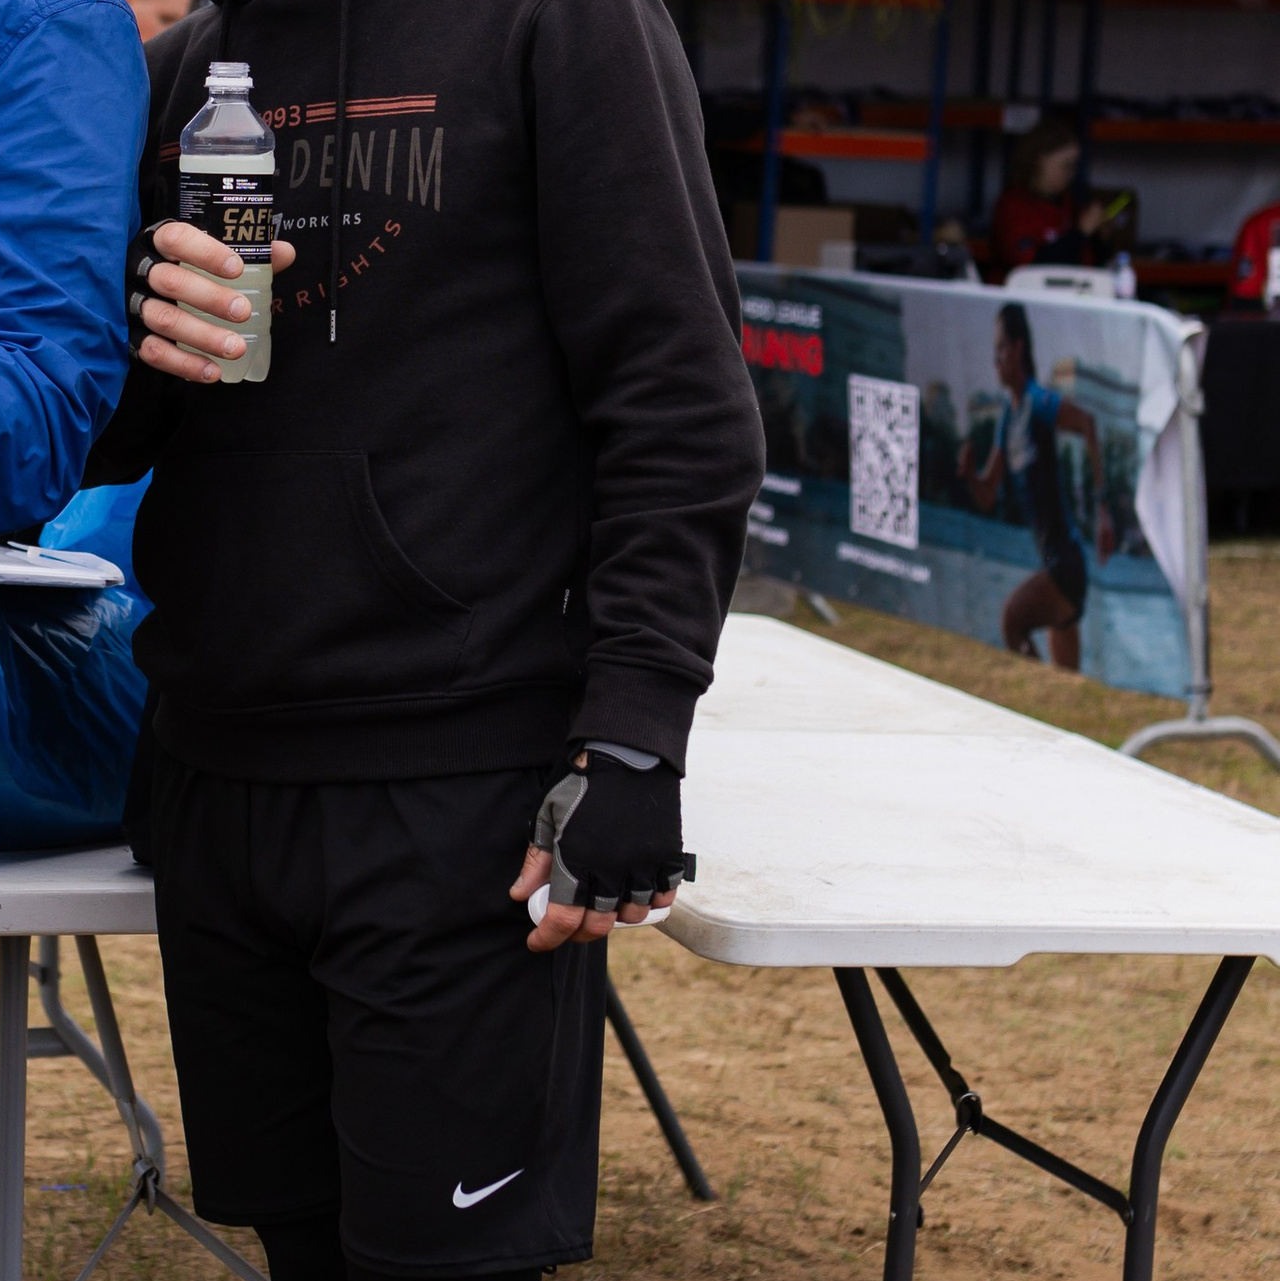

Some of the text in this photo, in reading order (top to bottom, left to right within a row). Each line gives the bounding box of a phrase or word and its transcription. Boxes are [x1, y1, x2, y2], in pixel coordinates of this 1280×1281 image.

[260, 104, 301, 129] 993
[289, 126, 444, 212] DENIM
[283, 212, 362, 231] WORKRS
